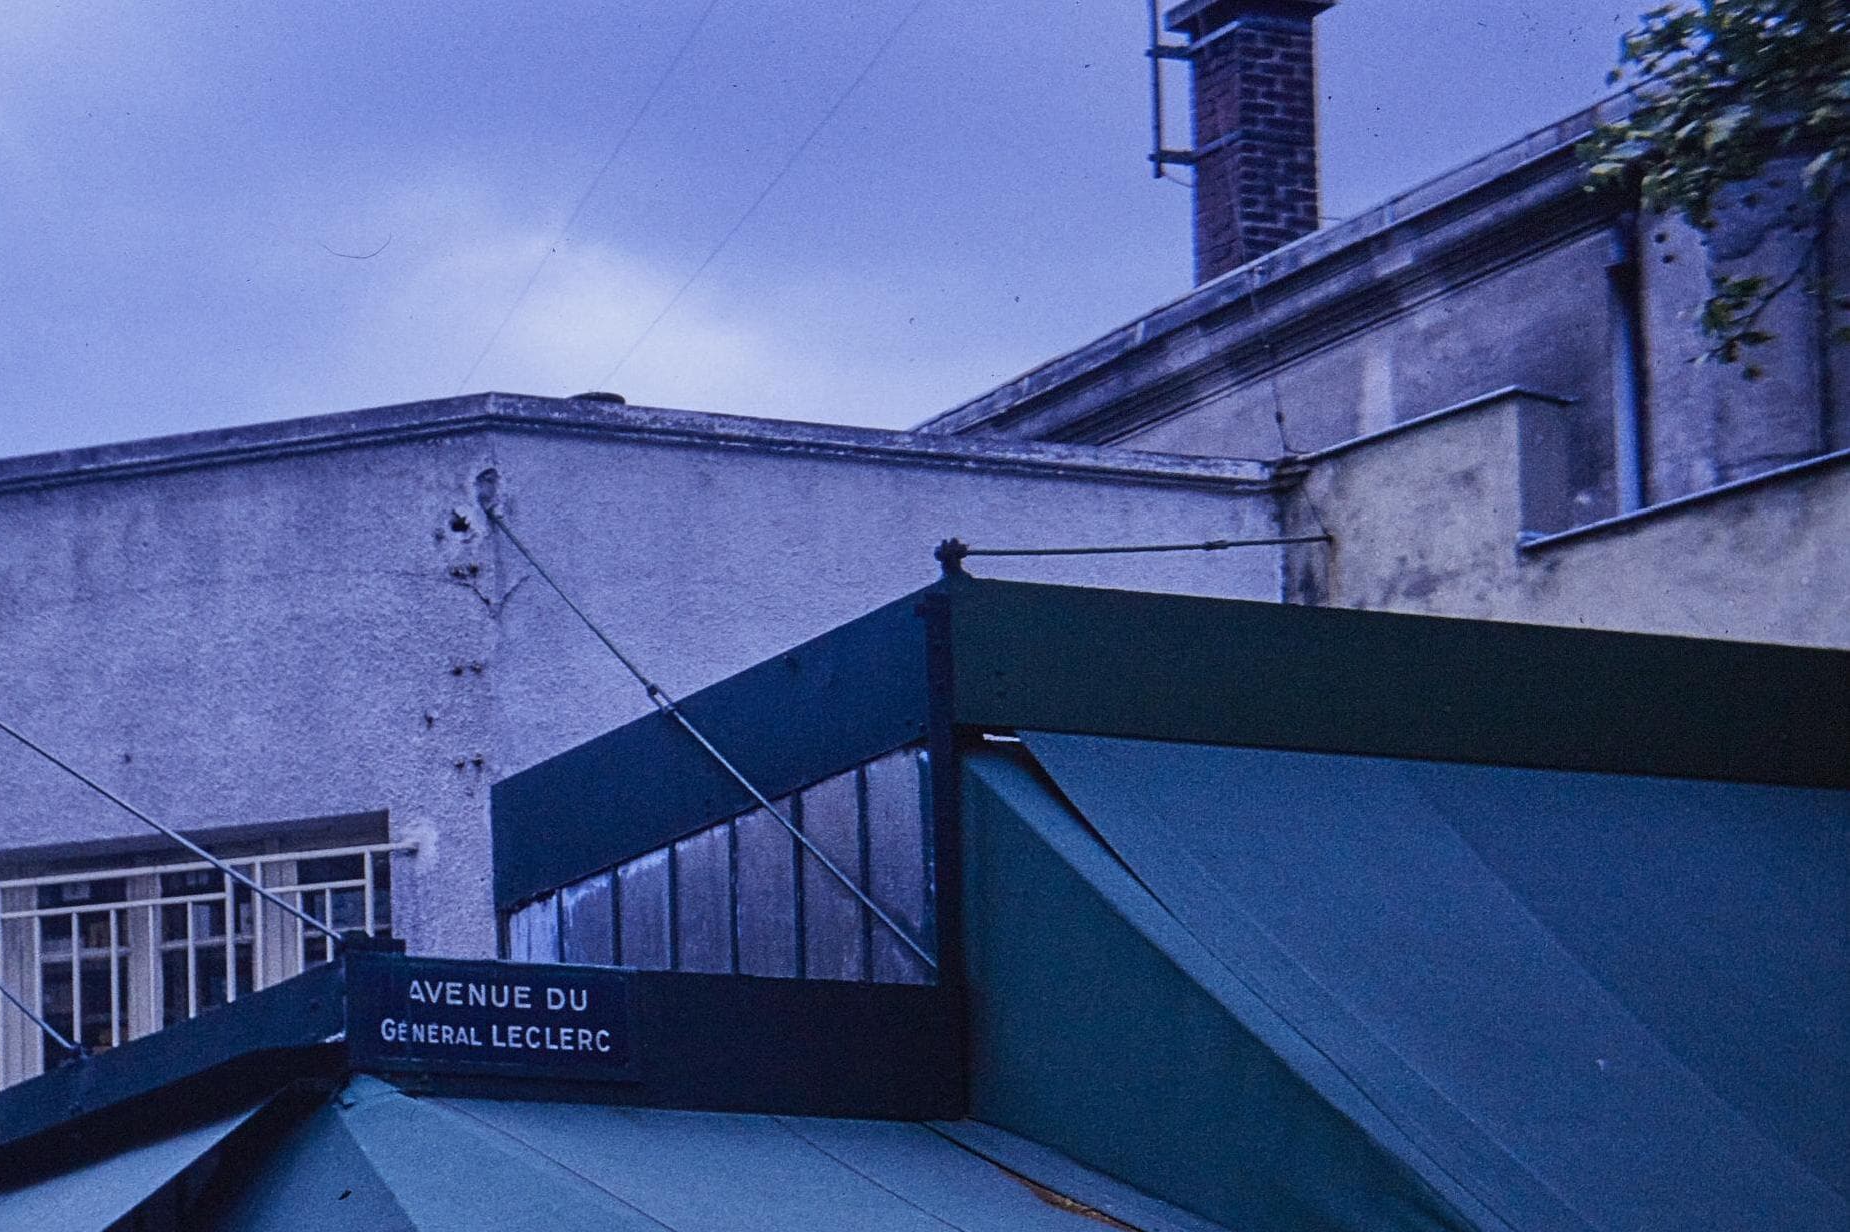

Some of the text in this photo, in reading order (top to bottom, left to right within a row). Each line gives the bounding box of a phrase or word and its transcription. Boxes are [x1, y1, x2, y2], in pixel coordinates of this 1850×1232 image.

[409, 979, 588, 1011] AVENUE DU
[491, 1024, 611, 1052] LECLERC
